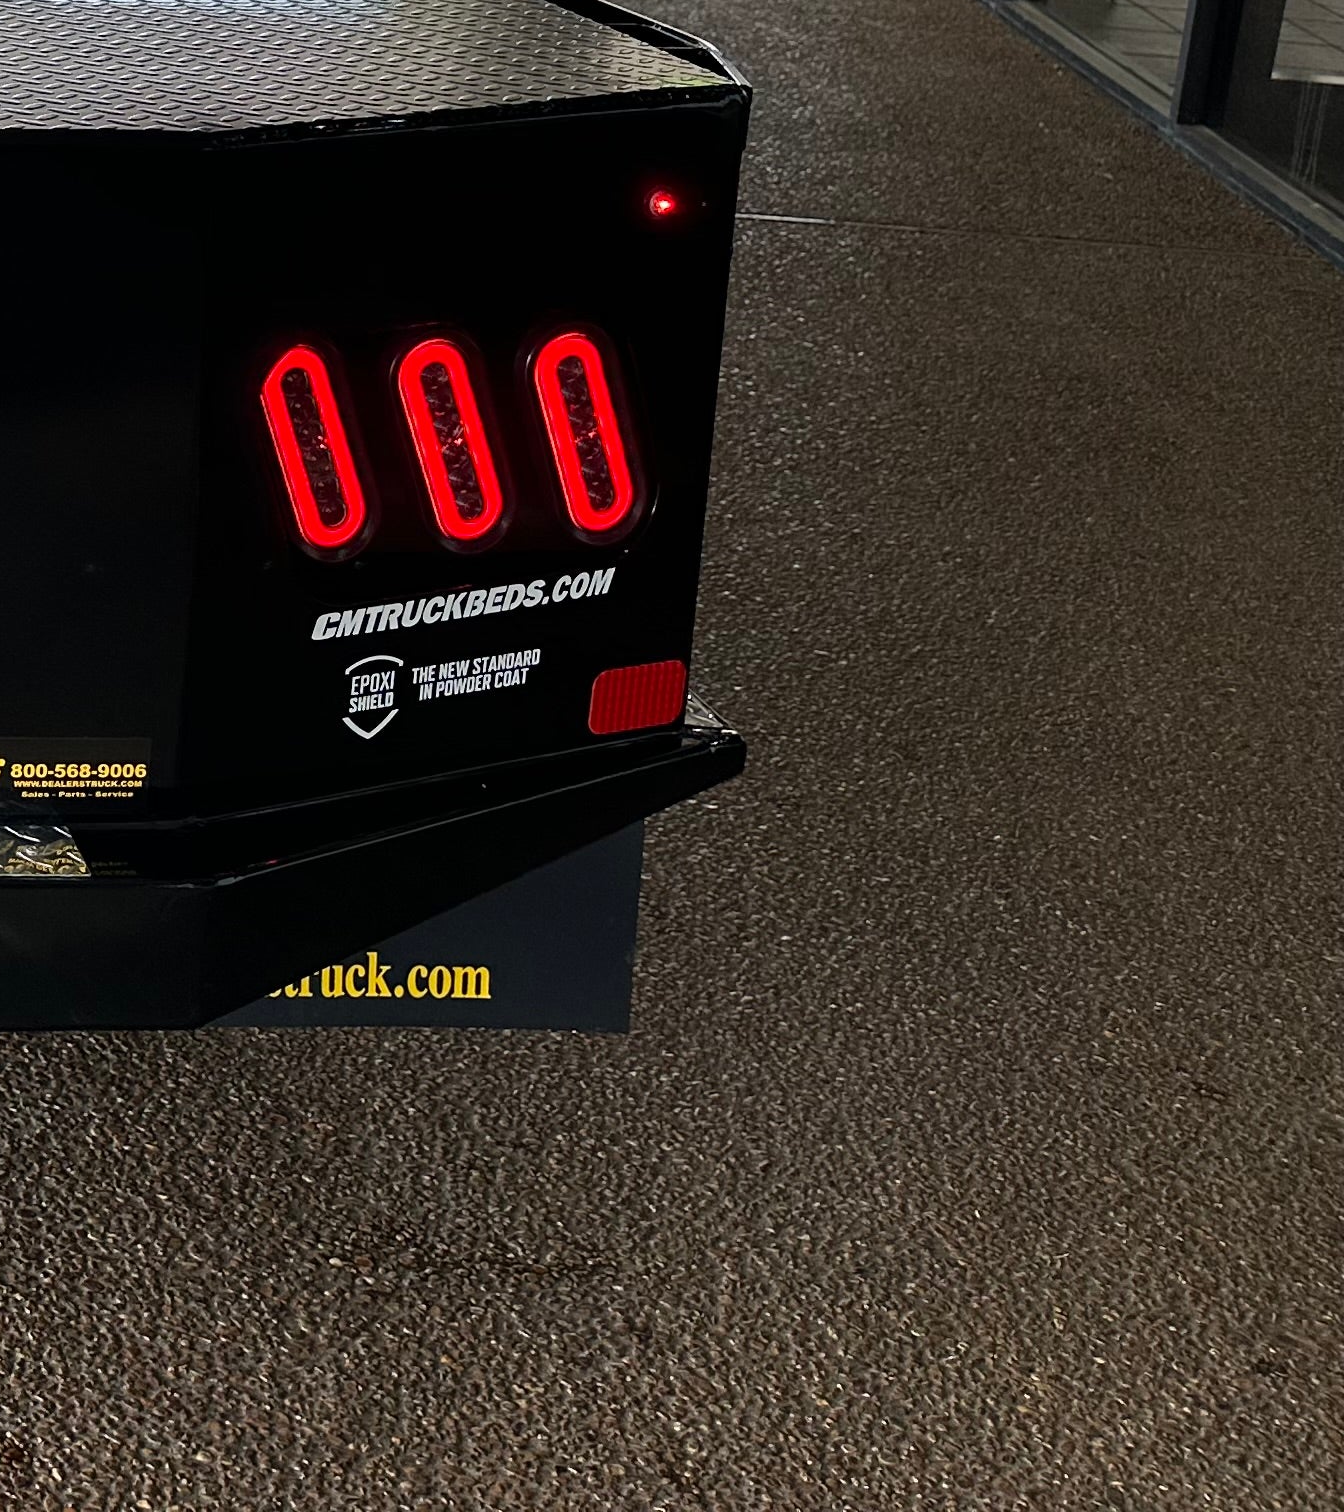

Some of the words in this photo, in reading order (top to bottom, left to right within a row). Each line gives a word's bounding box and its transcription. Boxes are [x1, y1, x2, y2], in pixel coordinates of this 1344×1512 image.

[311, 567, 616, 640] CMTRUCKBEDS.COM
[412, 665, 436, 684] THE
[439, 660, 470, 681] NEW
[473, 648, 541, 676] STANDARD
[351, 670, 395, 696] EPOXI
[418, 683, 433, 701] IN
[436, 674, 491, 698] POWDER
[494, 668, 530, 689] COAT
[348, 691, 394, 713] SHIELD
[10, 763, 148, 779] 800-568-9006
[13, 780, 143, 788] WWW.DEALERSTRUCK.COM
